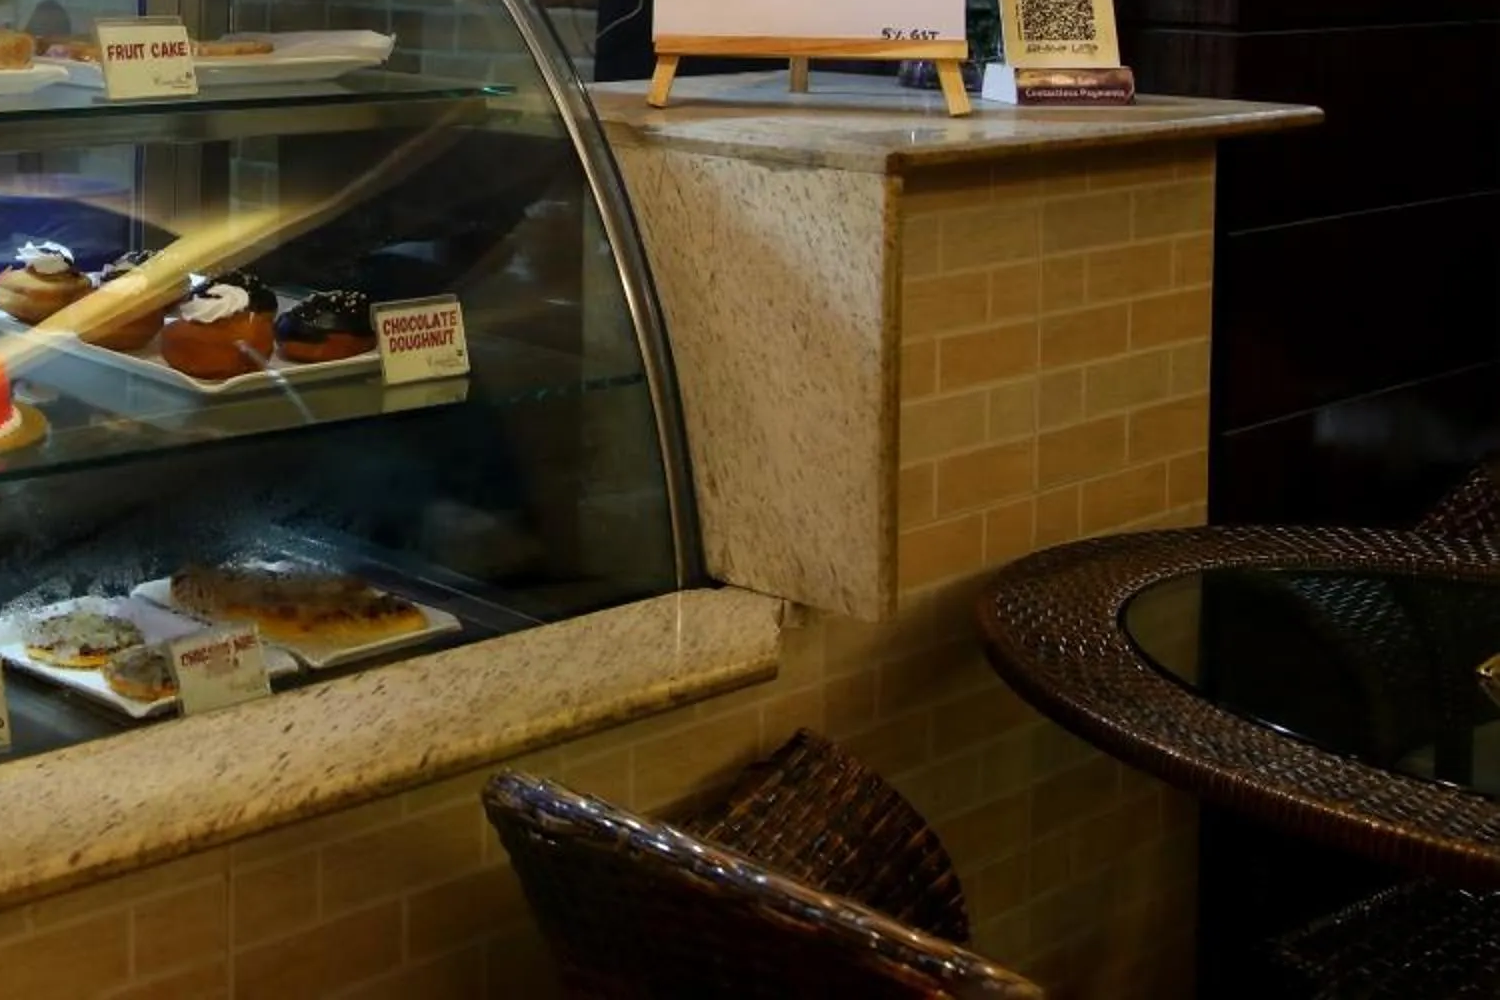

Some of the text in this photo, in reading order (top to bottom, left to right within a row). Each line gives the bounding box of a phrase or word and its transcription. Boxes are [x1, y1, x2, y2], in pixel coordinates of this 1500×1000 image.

[107, 41, 188, 61] FRUIT CAKE
[382, 309, 457, 337] CHOCOLATE
[389, 328, 455, 354] DOUGHNUT
